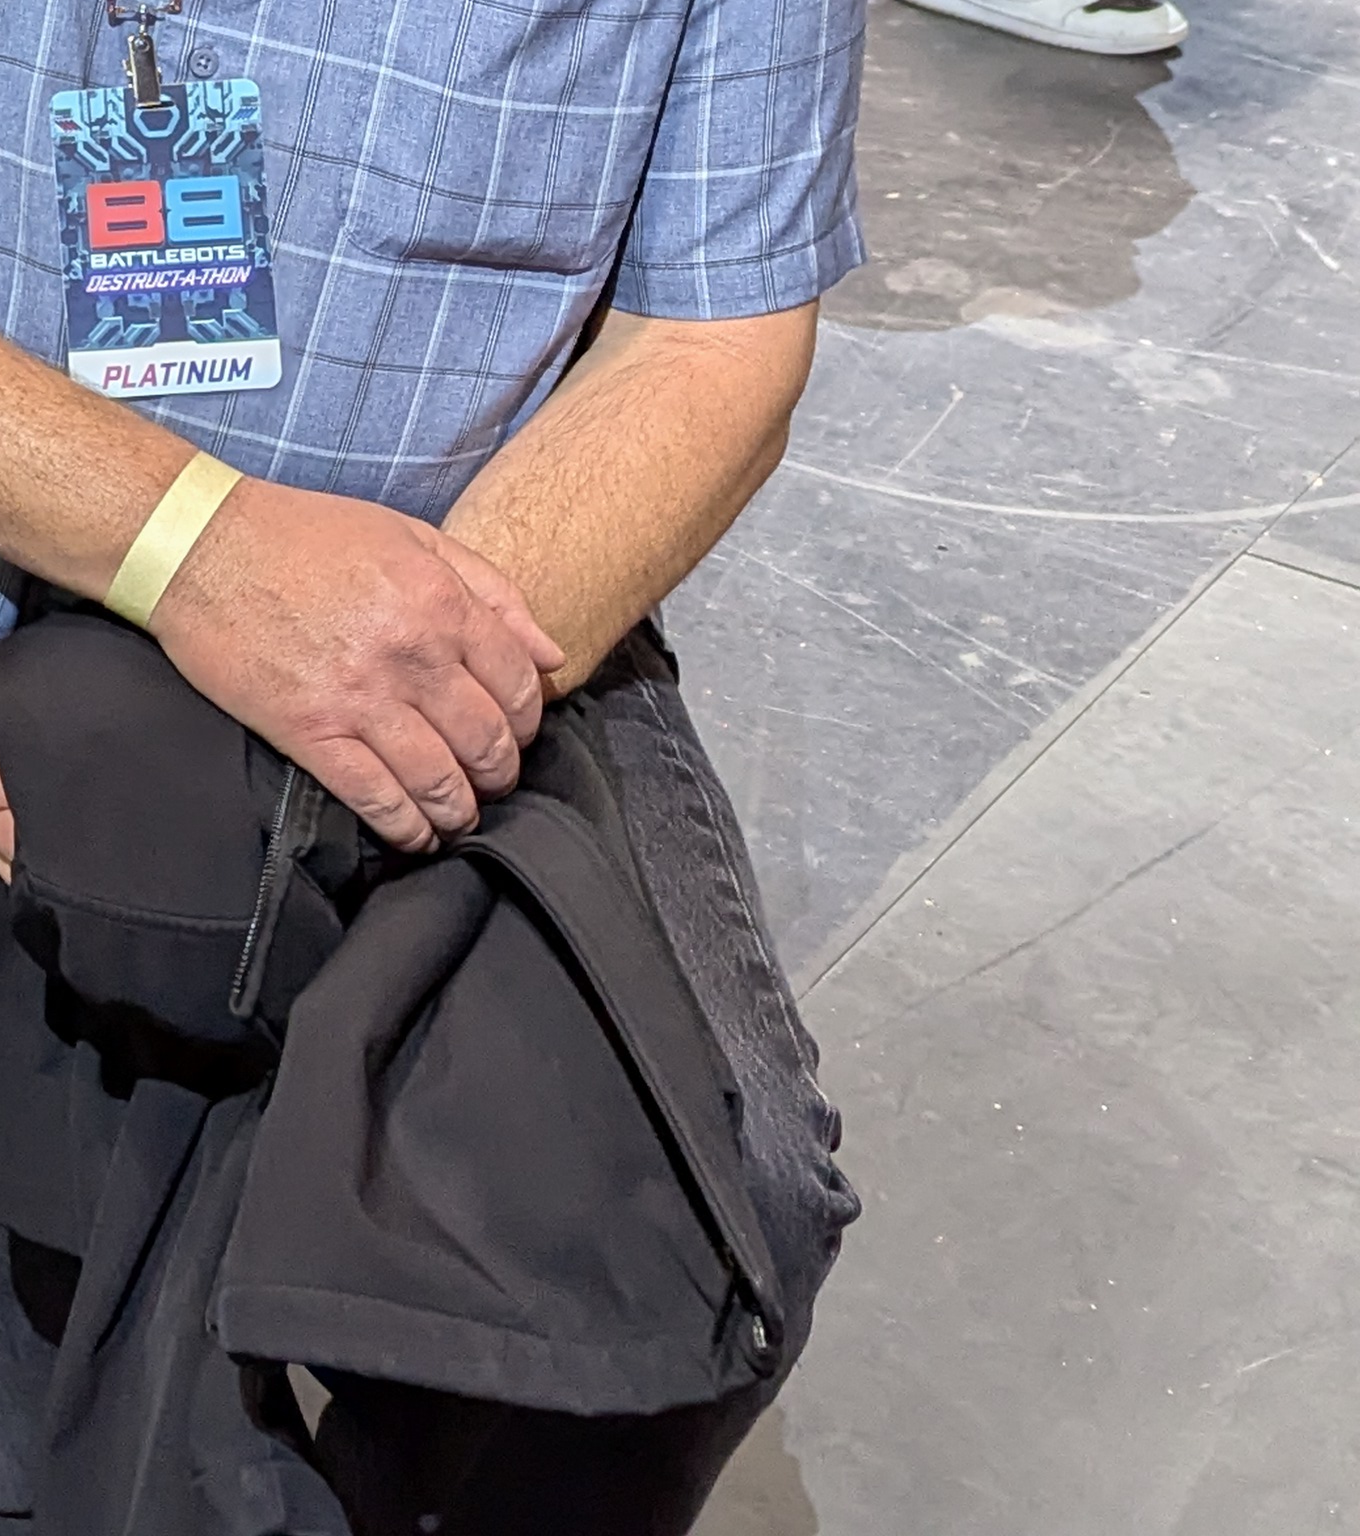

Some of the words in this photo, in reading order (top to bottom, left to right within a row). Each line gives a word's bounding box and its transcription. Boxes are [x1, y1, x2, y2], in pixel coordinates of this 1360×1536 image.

[91, 247, 246, 268] BATTLEBOTS
[86, 266, 252, 294] DESTRUCT-A-THON
[102, 357, 253, 390] PLATINUM
